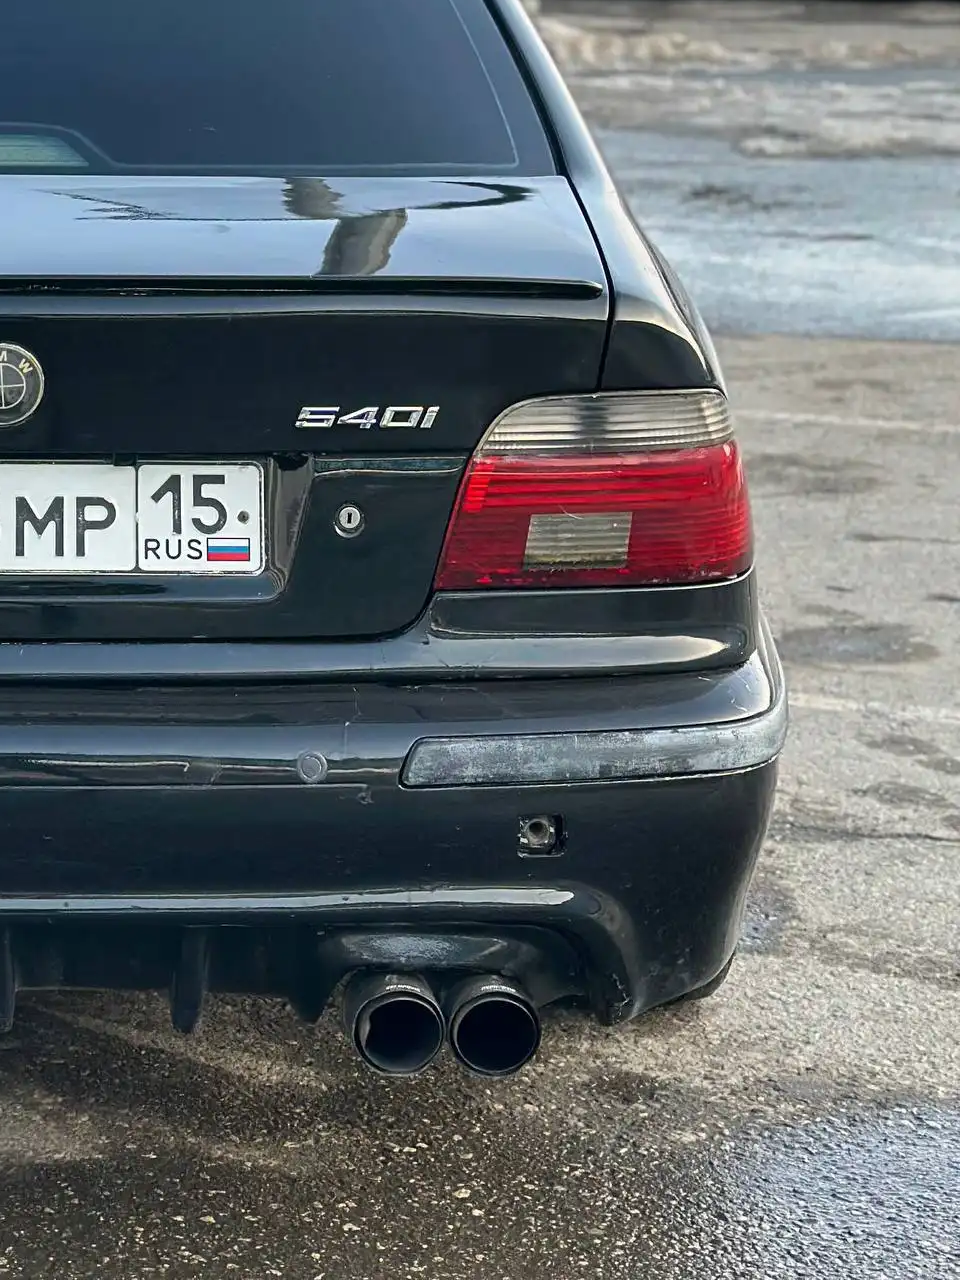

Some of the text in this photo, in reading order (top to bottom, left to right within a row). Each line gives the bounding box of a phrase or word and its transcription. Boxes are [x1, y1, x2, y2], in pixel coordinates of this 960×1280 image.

[295, 406, 440, 429] 540i
[150, 474, 228, 535] 15
[143, 537, 203, 560] RUS
